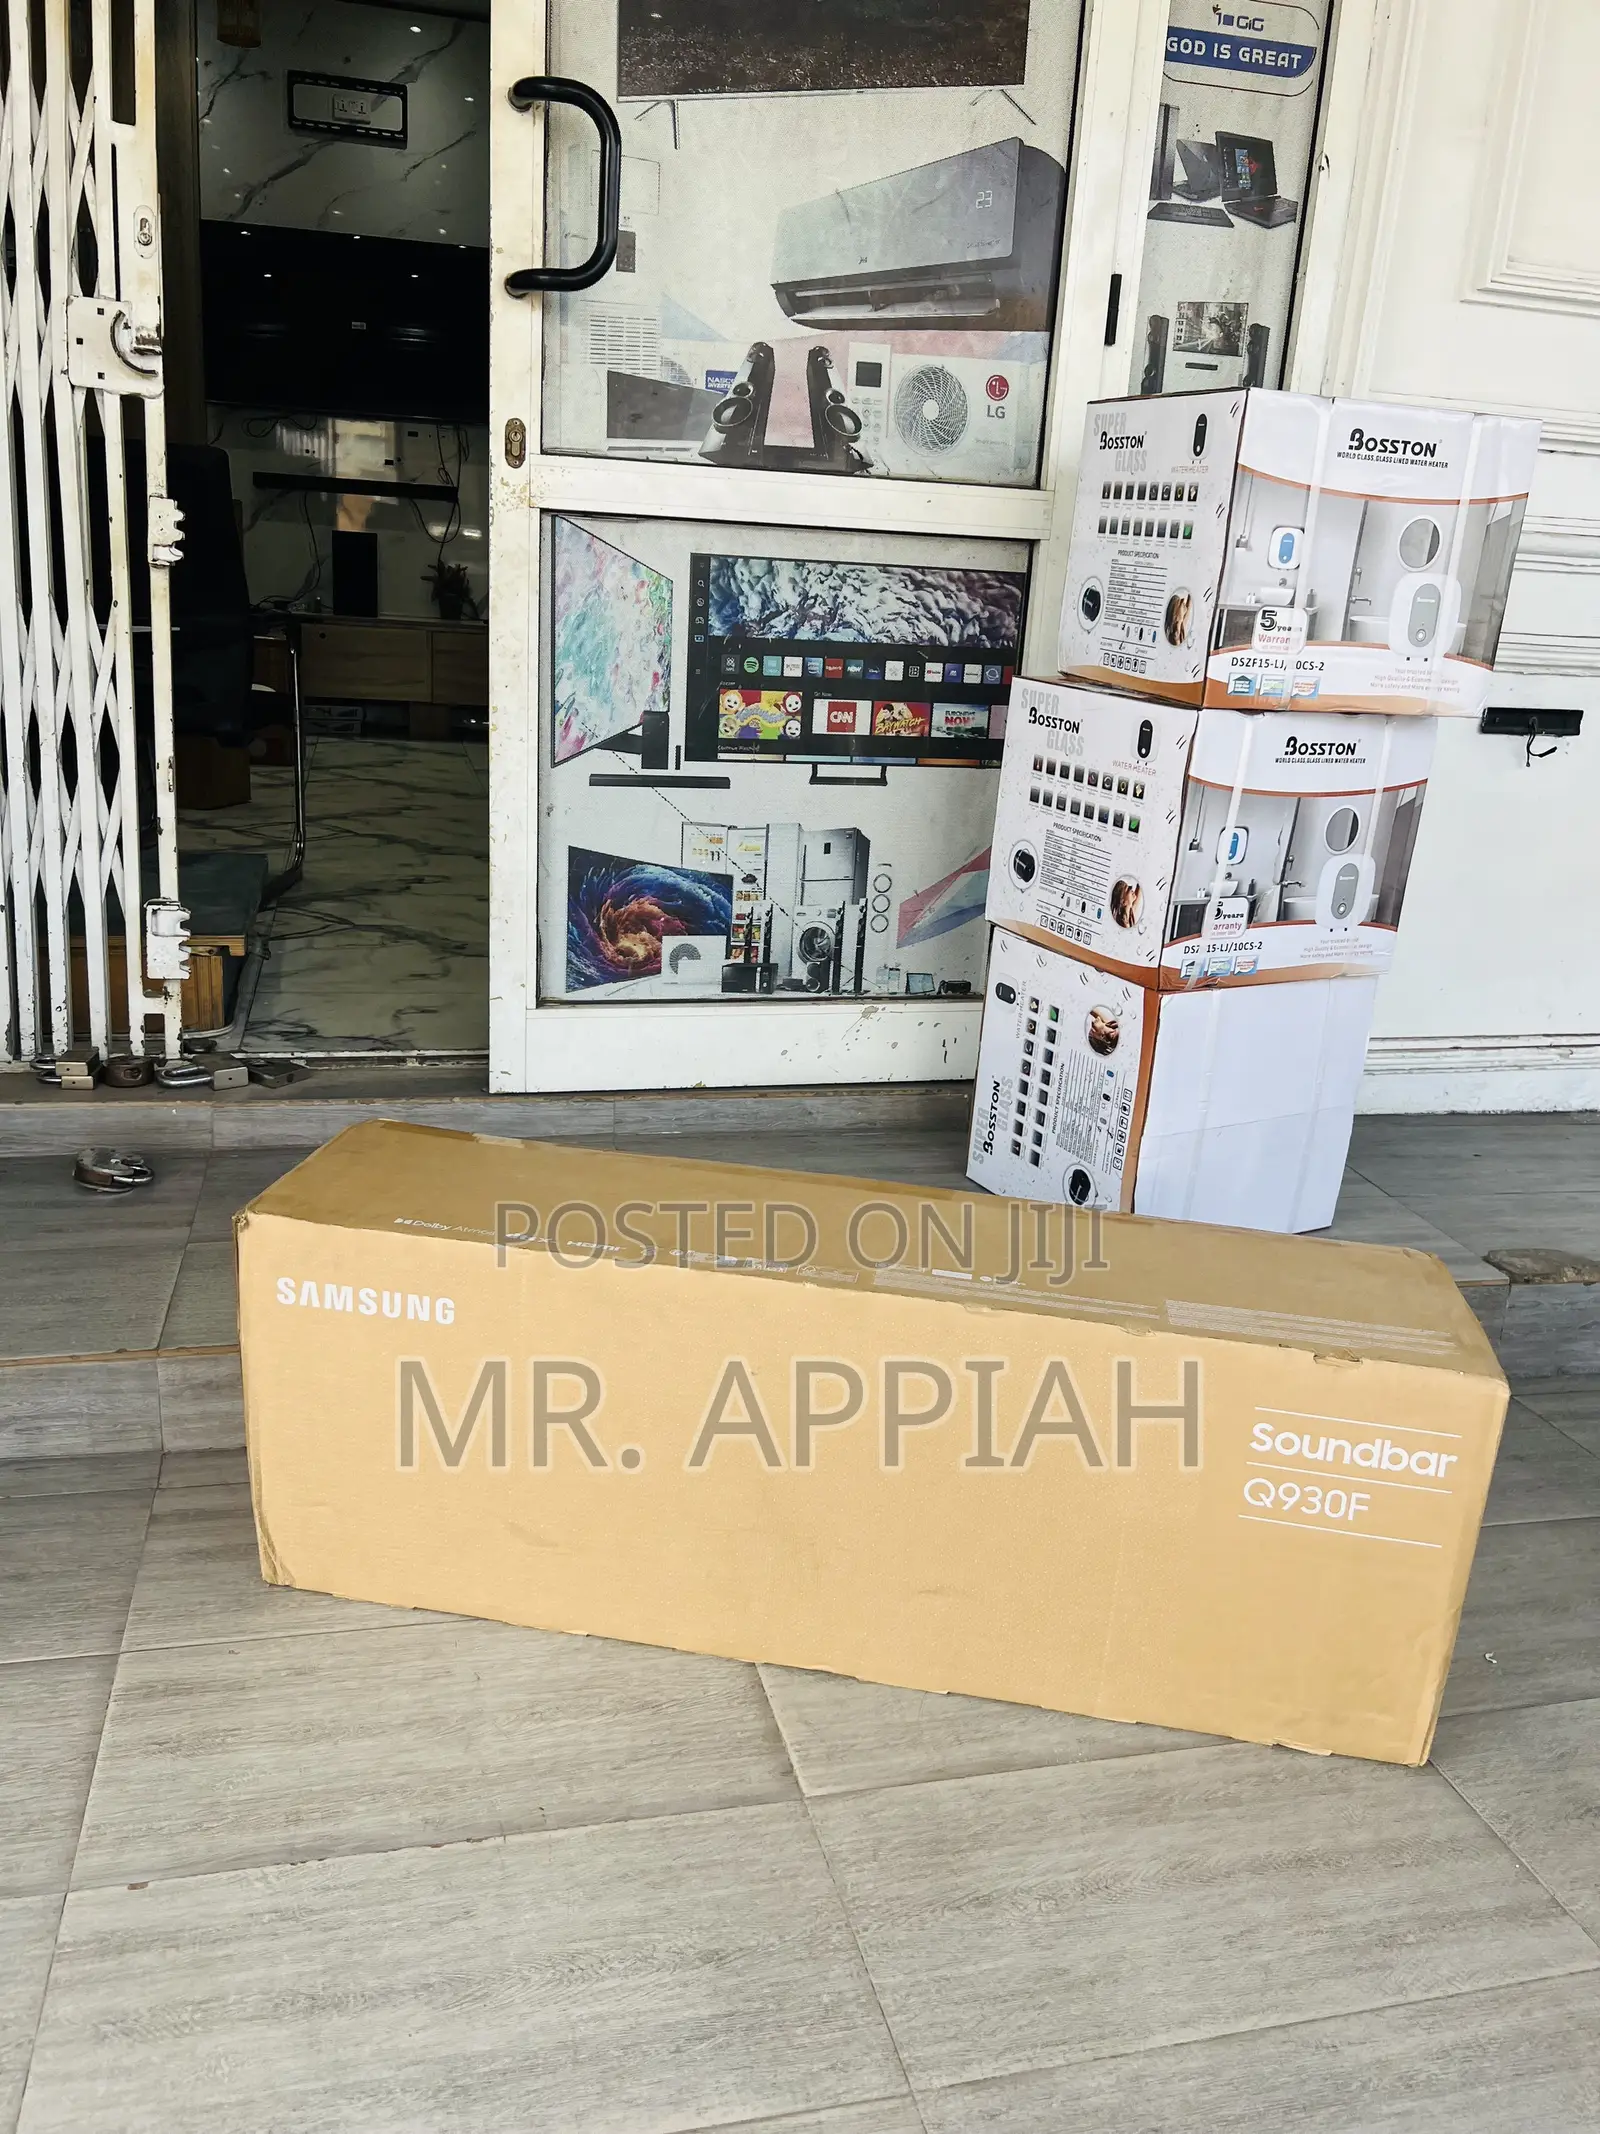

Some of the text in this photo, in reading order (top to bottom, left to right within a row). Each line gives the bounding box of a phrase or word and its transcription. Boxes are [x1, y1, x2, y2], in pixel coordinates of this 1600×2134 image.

[1166, 36, 1302, 69] GOD IS GREAT
[975, 190, 993, 209] 23
[986, 404, 1006, 419] LG
[1093, 412, 1127, 436] SUPER
[1099, 430, 1145, 450] BOSSTON
[1348, 428, 1437, 458] BOSSTON
[1115, 450, 1147, 473] GLASS
[1336, 451, 1356, 460] WORLD
[1393, 457, 1409, 465] LINED
[1410, 458, 1428, 467] WATER
[1428, 460, 1449, 469] HEATER
[1259, 609, 1277, 631] 5
[1021, 687, 1060, 716] SUPER
[829, 711, 854, 724] CNN
[875, 717, 925, 734] BAYWATCH
[944, 716, 976, 726] NOW
[1028, 706, 1080, 734] BOSSTON
[1046, 730, 1085, 757] GLASS
[1284, 735, 1357, 756] BOSSTON
[1112, 759, 1157, 776] WATER HEATER
[1052, 821, 1072, 833] PRODUCT
[1213, 921, 1242, 930] arranty
[1222, 912, 1244, 920] years
[1015, 980, 1028, 1039] WATER HEATER
[997, 1076, 1014, 1132] GLASS
[1052, 1063, 1065, 1134] PRODUCT SPECIFICATION
[983, 1080, 1001, 1156] BOSSTON
[972, 1107, 990, 1165] SUPER
[412, 1220, 453, 1231] Dolby
[276, 1276, 455, 1325] SAMSUNG
[1249, 1422, 1458, 1479] Soundbar
[1243, 1477, 1371, 1521] Q930F
